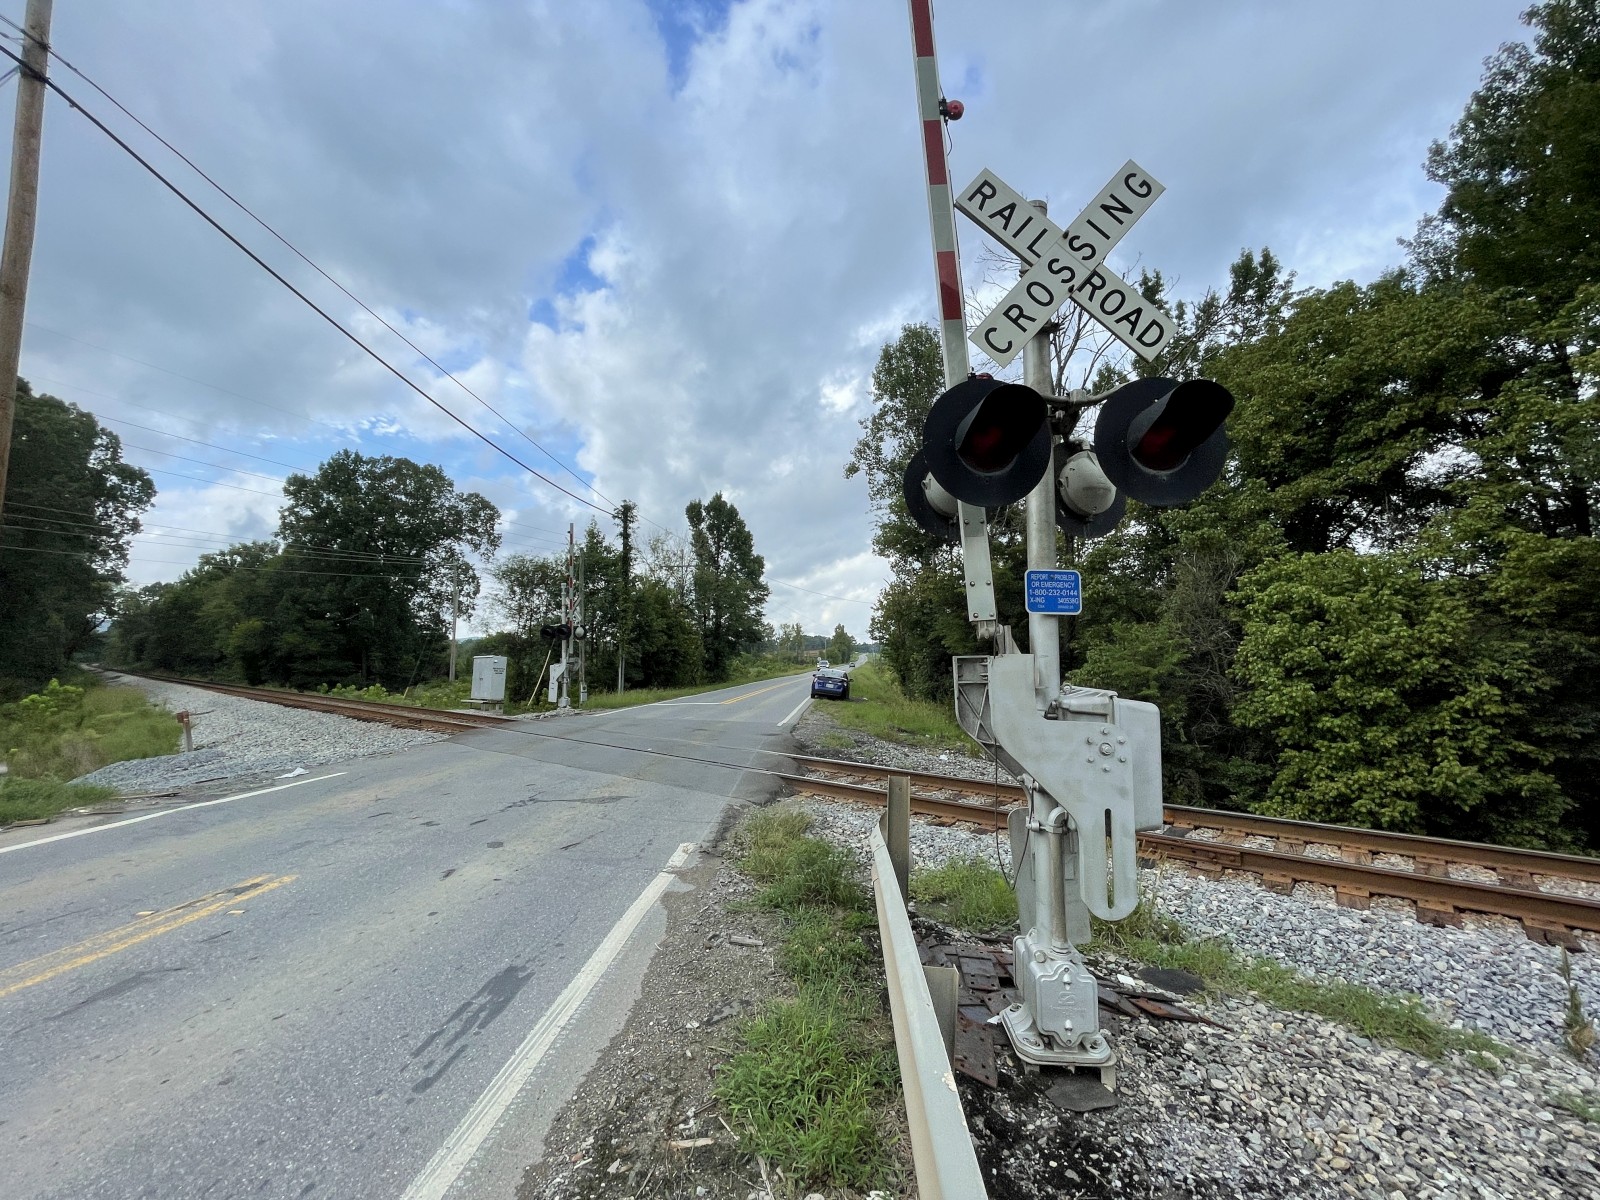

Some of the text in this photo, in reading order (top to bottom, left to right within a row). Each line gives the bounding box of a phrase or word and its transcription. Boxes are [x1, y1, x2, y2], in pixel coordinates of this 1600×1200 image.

[967, 178, 1166, 349] RAIL ROAD
[983, 172, 1153, 355] CROSSING
